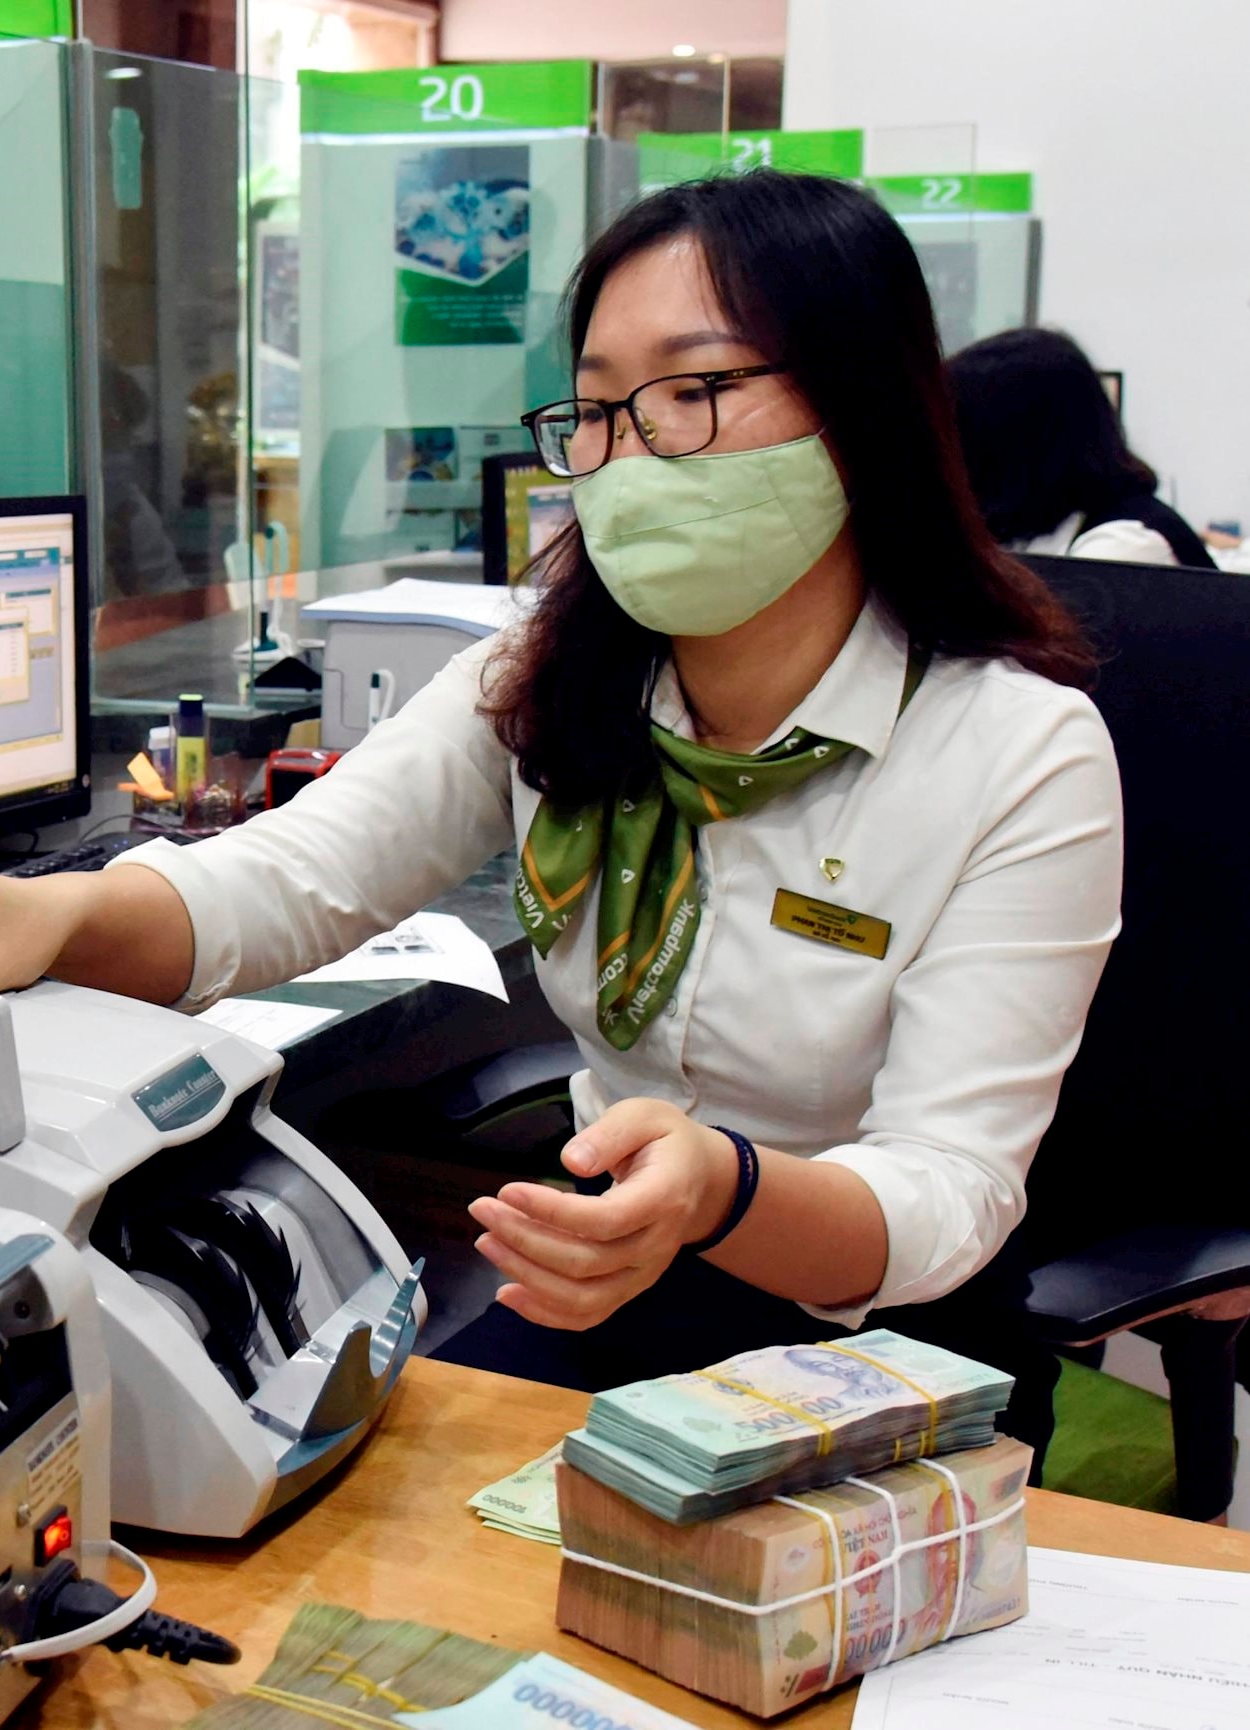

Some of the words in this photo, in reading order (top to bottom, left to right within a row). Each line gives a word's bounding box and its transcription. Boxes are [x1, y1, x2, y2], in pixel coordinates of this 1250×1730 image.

[419, 75, 484, 121] 20
[733, 138, 773, 173] 21
[921, 178, 962, 208] 22
[626, 898, 695, 1025] Vietcombank
